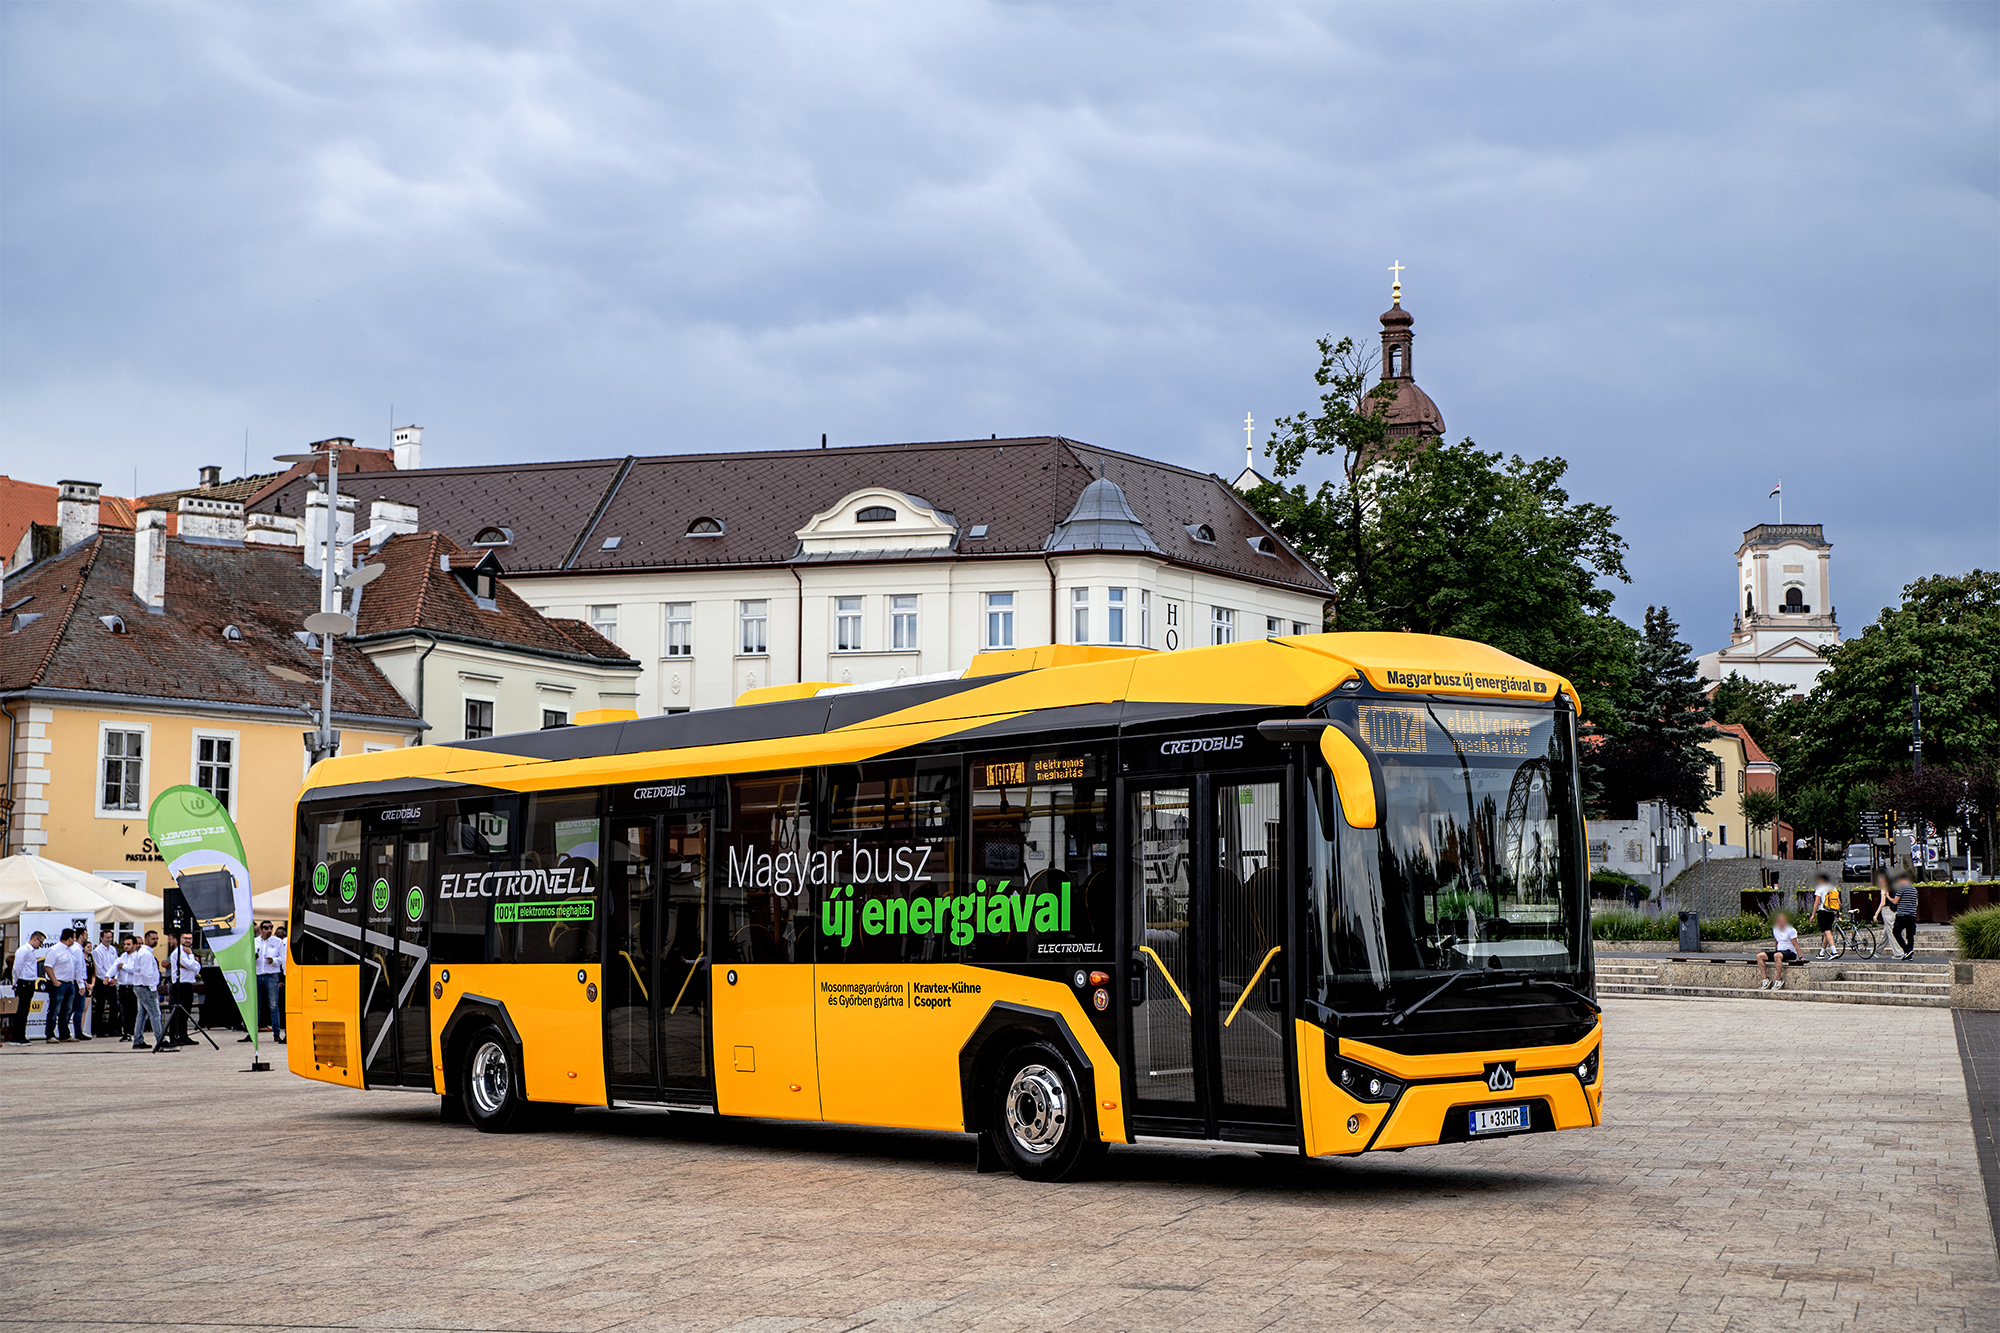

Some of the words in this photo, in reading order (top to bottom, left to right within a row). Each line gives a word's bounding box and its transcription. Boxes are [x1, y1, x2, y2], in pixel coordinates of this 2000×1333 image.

[1387, 671, 1431, 687] Magyar
[1433, 673, 1461, 686] busz
[1464, 674, 1473, 690] új
[1475, 677, 1531, 692] energiával
[1448, 710, 1530, 736] elektromos
[1160, 735, 1244, 755] CREDOBUS
[1034, 759, 1084, 771] elektromos
[1452, 771, 1501, 780] CRDOBUS
[633, 785, 686, 799] CREDOBUS
[381, 808, 421, 820] CREDOBUS
[727, 843, 842, 897] Magyar
[852, 838, 932, 884] busz
[316, 871, 326, 886] 11t
[440, 867, 595, 899] ELECTRONELL
[375, 888, 386, 900] 300
[496, 906, 515, 920] 100%
[520, 907, 555, 917] elektromos
[557, 905, 590, 917] meghajtás
[821, 885, 854, 947] új
[862, 879, 1071, 946] energiával
[1038, 943, 1103, 953] ELECTRONELL
[821, 981, 903, 995] Mosonmagyaróváron
[914, 981, 981, 994] Kravtex-Kühne
[828, 995, 838, 1005] és
[839, 995, 872, 1008] Győrben
[874, 995, 903, 1008] gyártva
[914, 996, 951, 1009] Csoport
[1494, 1110, 1519, 1126] 33HR
